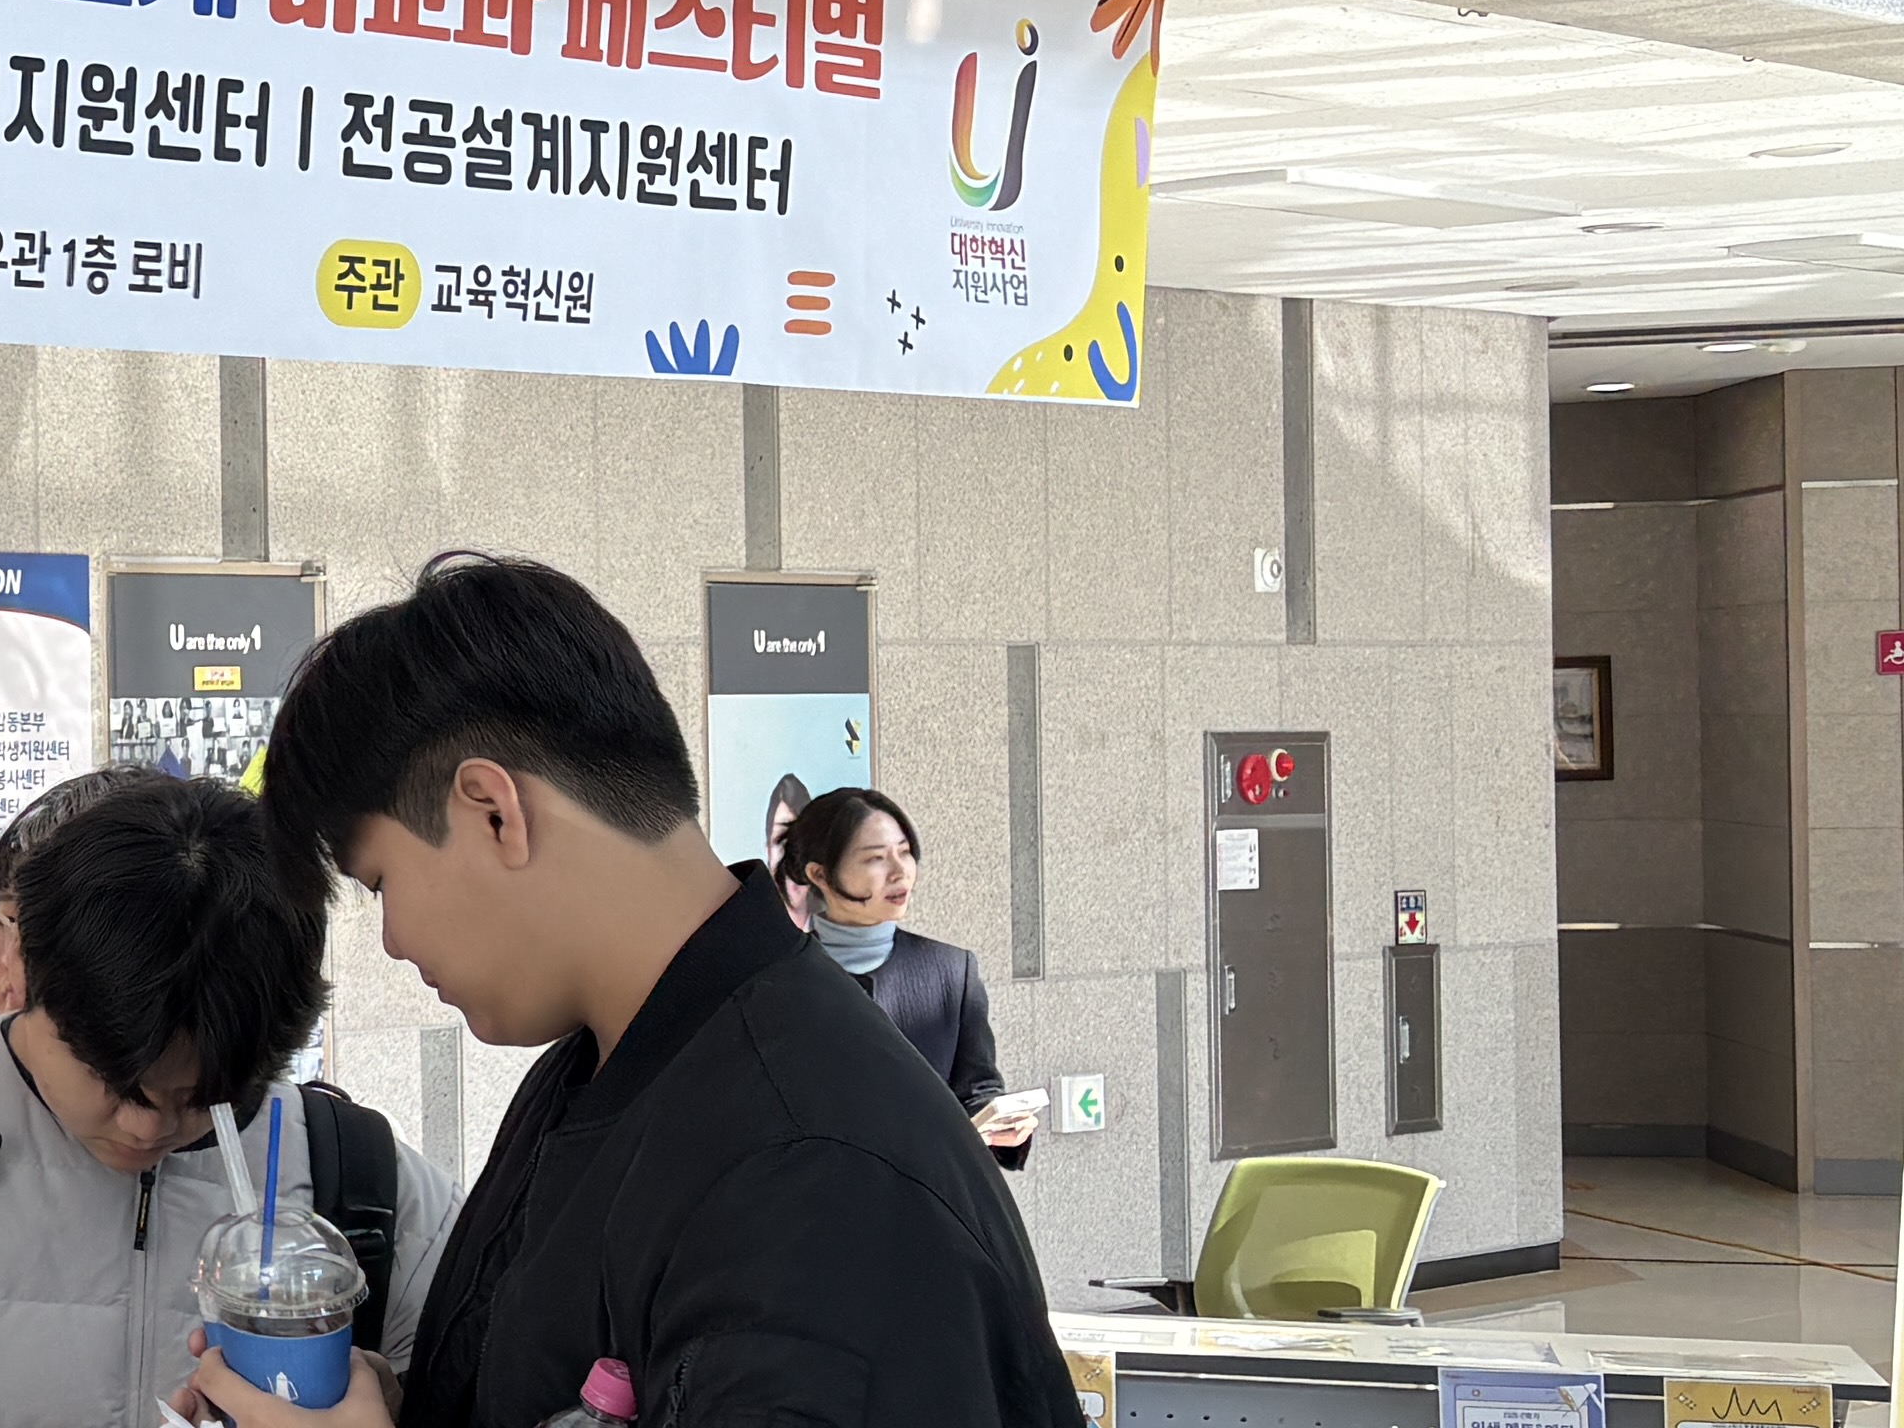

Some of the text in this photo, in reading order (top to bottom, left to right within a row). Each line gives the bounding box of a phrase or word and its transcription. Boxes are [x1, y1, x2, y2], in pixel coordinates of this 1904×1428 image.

[339, 91, 794, 217] 전공설계지원센터
[61, 233, 118, 296] 1층
[127, 239, 204, 300] 로비
[950, 231, 1027, 271] 대학혁신
[333, 254, 595, 325] 주관 교육혁신원
[951, 268, 1029, 307] 지원사업
